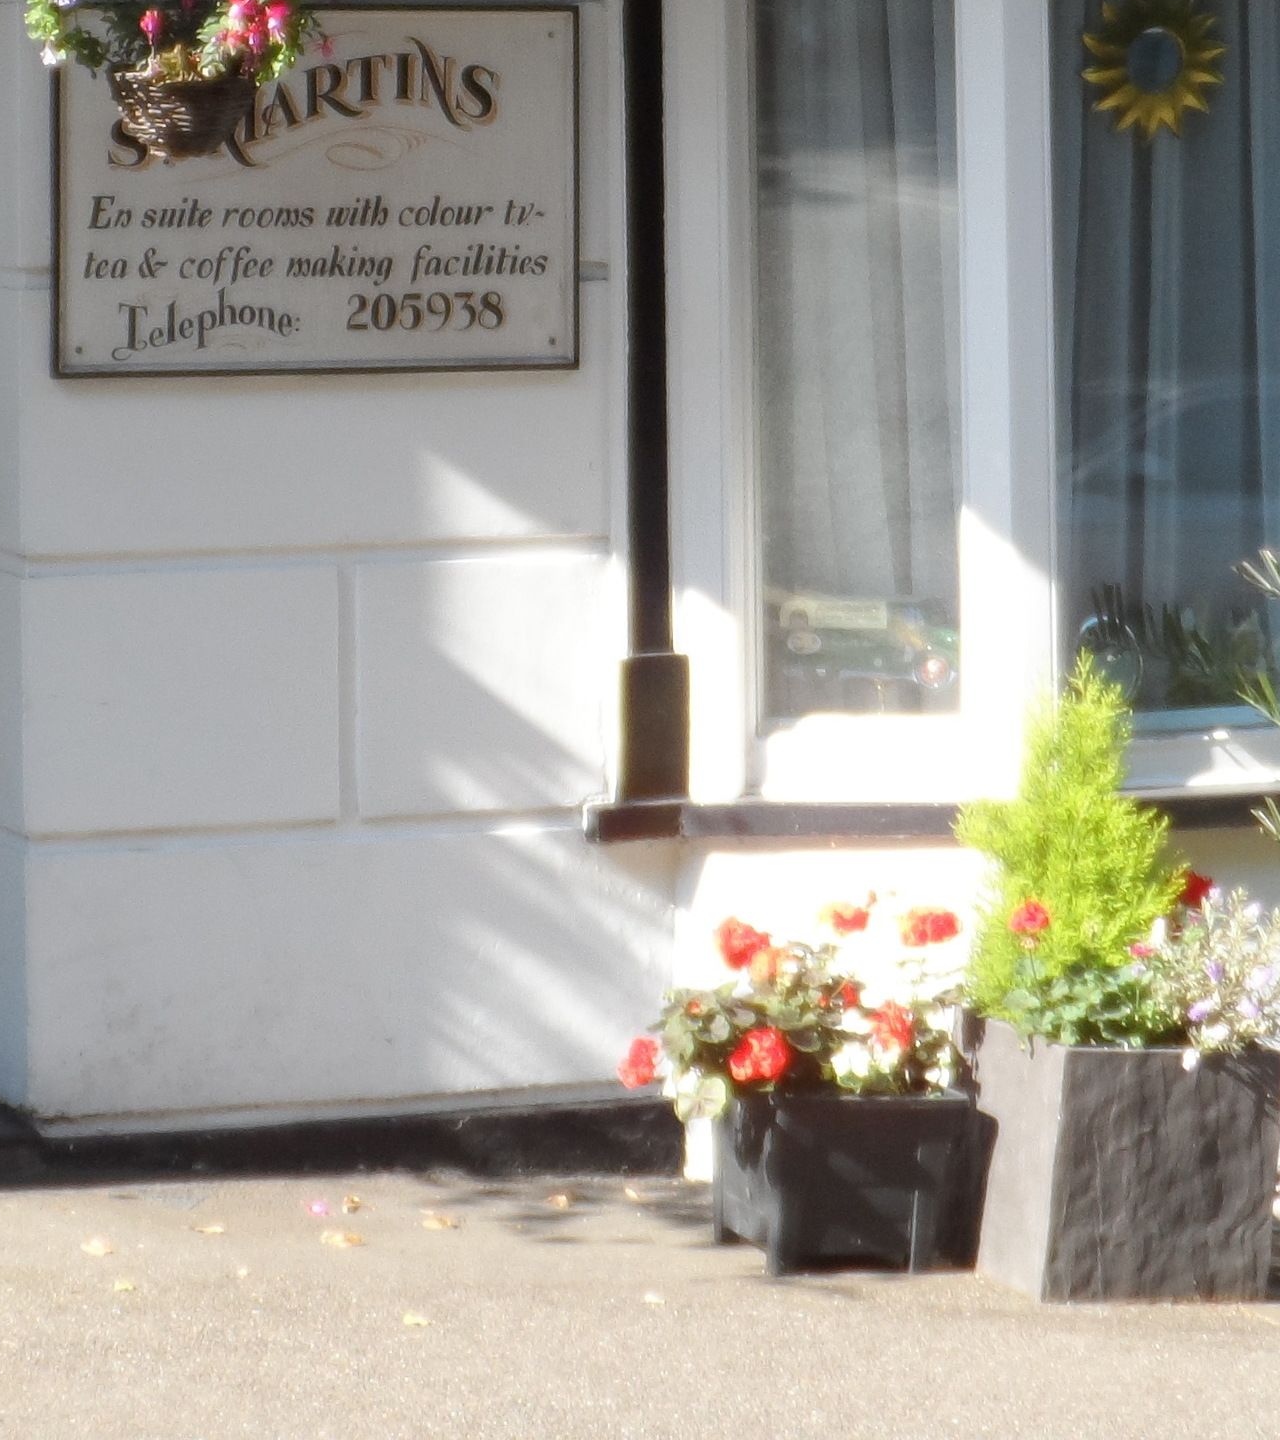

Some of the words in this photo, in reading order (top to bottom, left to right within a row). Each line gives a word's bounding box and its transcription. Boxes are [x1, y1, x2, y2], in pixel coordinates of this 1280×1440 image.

[87, 195, 132, 229] En
[140, 197, 212, 228] suite
[221, 207, 315, 228] rooms
[326, 195, 388, 227] with
[398, 195, 494, 227] colour
[83, 251, 128, 279] tea
[138, 247, 168, 279] &
[179, 246, 274, 286] coffee
[286, 244, 394, 286] making
[410, 243, 549, 285] facilities
[111, 287, 300, 360] Telephone:
[346, 291, 505, 331] 205938
